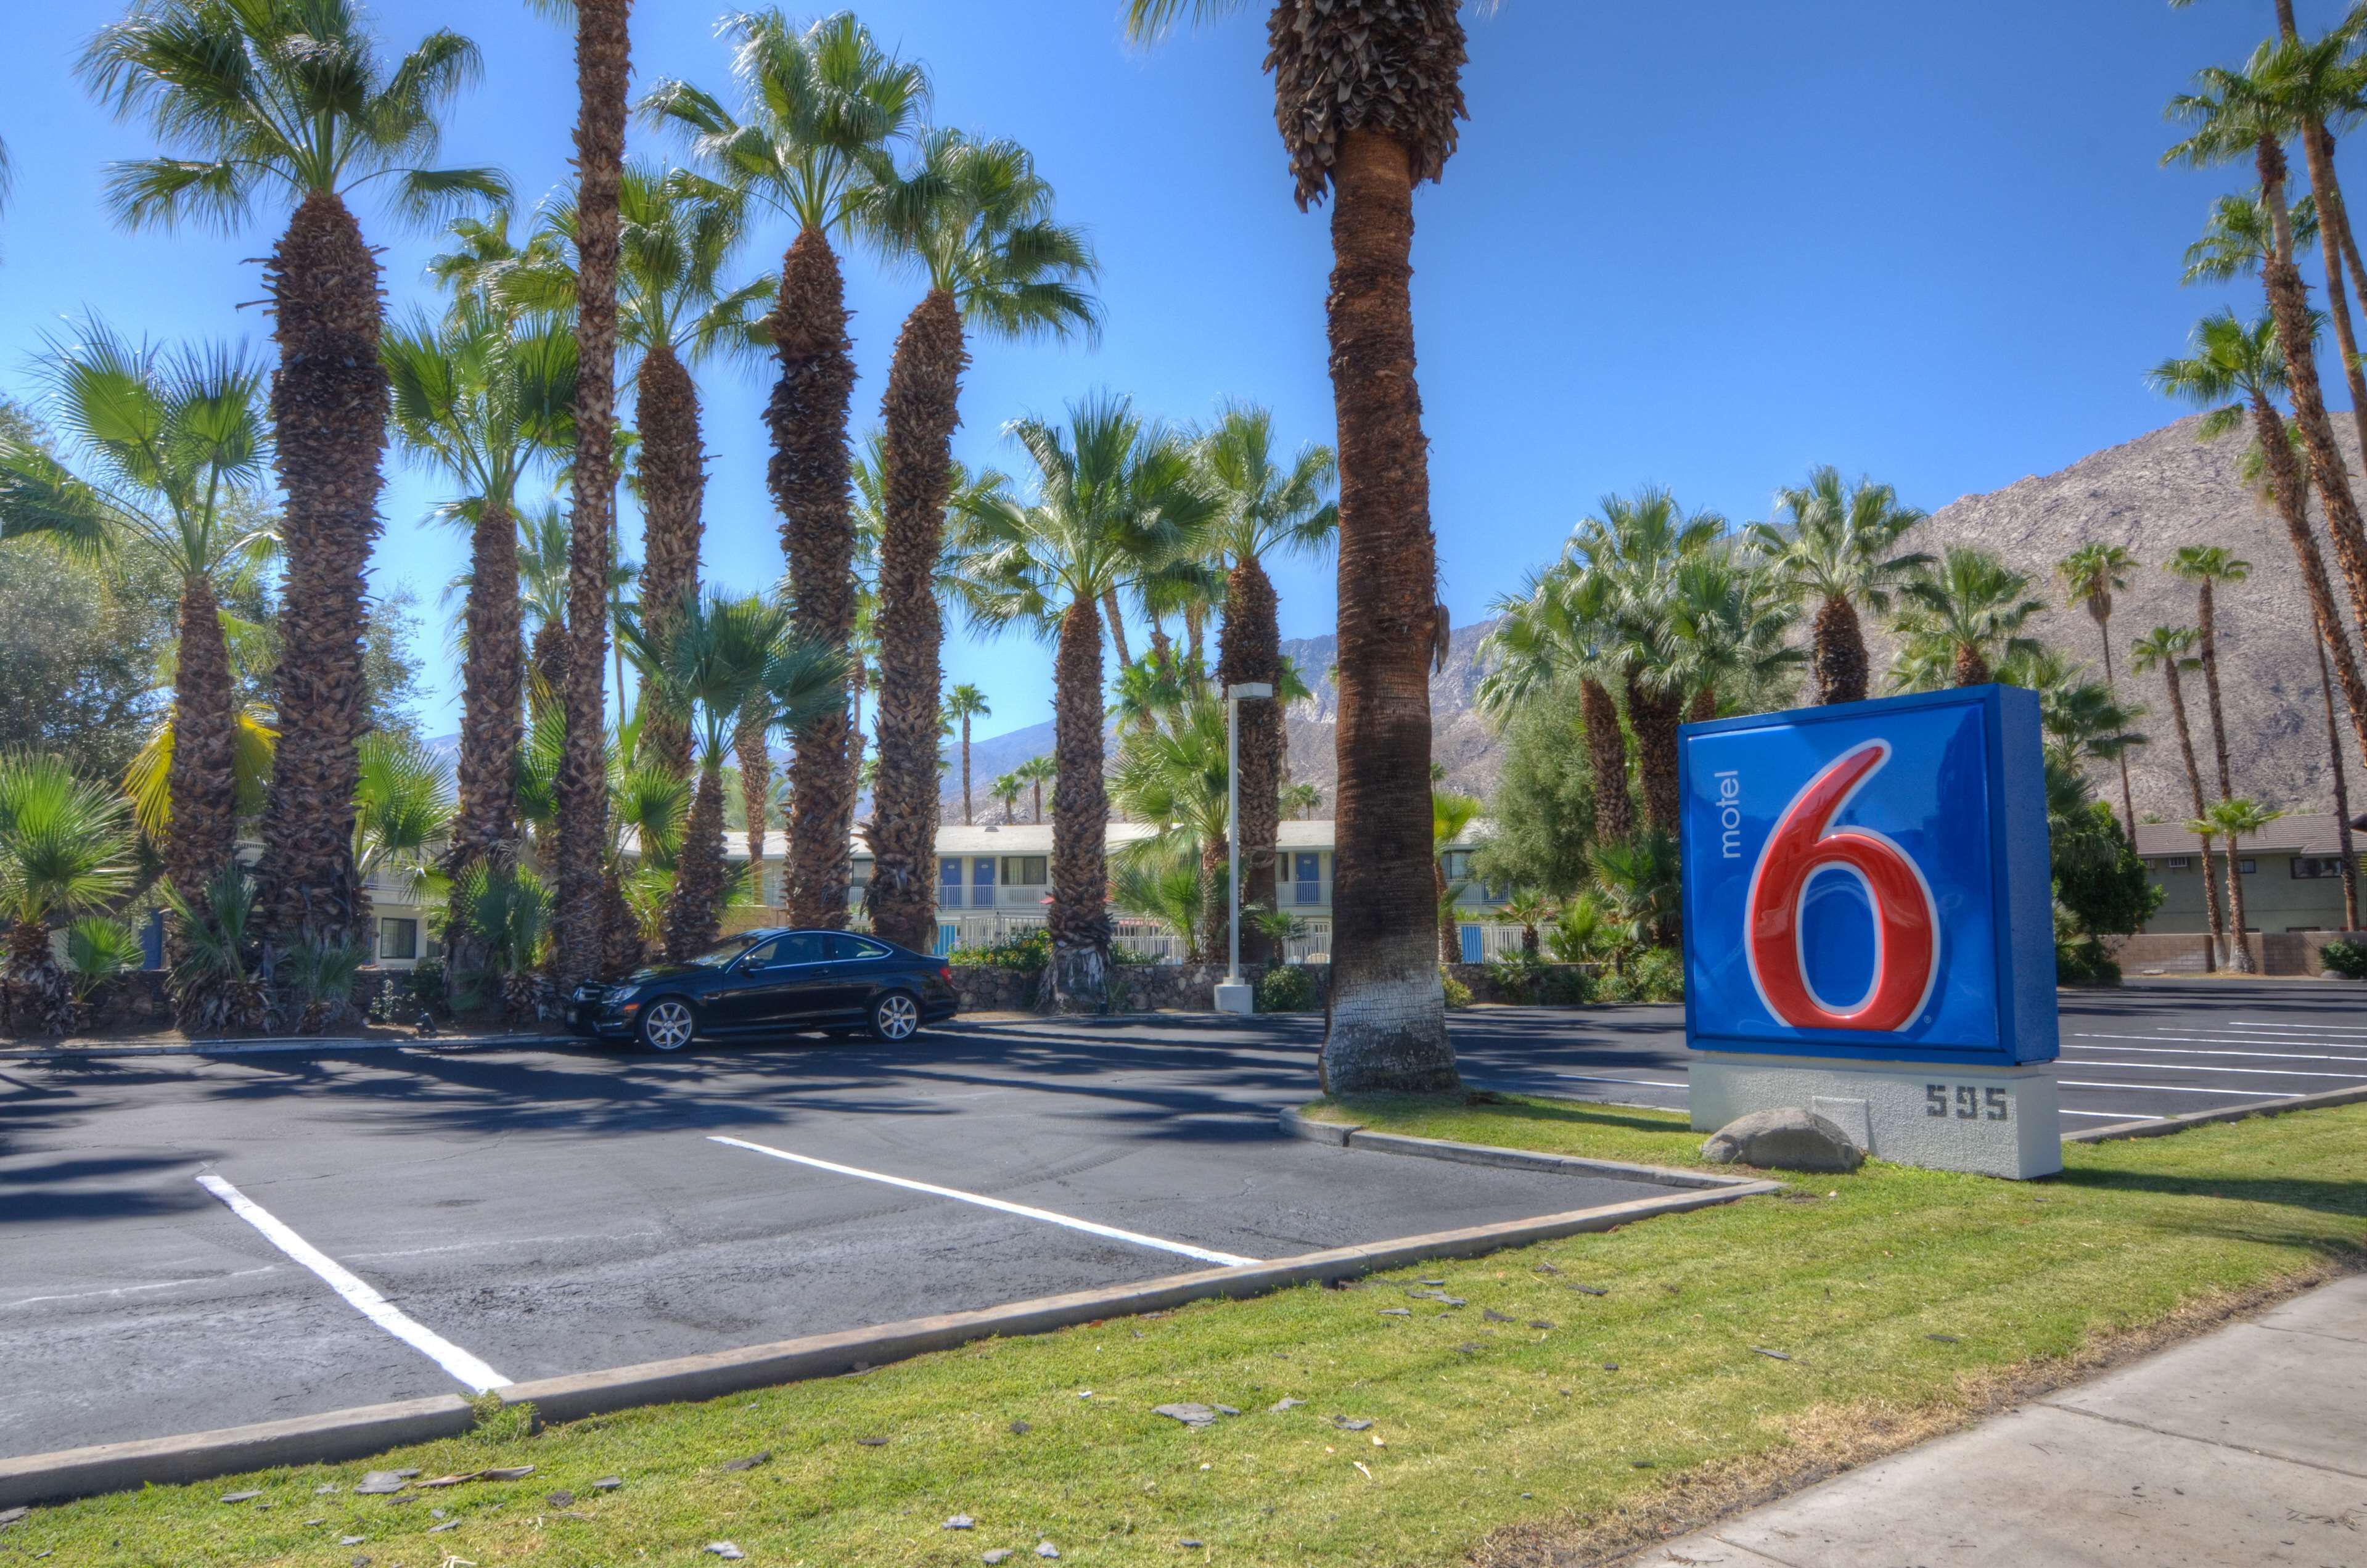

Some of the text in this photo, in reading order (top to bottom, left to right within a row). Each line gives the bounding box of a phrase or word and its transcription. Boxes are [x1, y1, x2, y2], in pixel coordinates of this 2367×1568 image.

[1714, 770, 1741, 858] motel
[1744, 738, 1940, 1032] 6
[1926, 1084, 2008, 1120] 595
